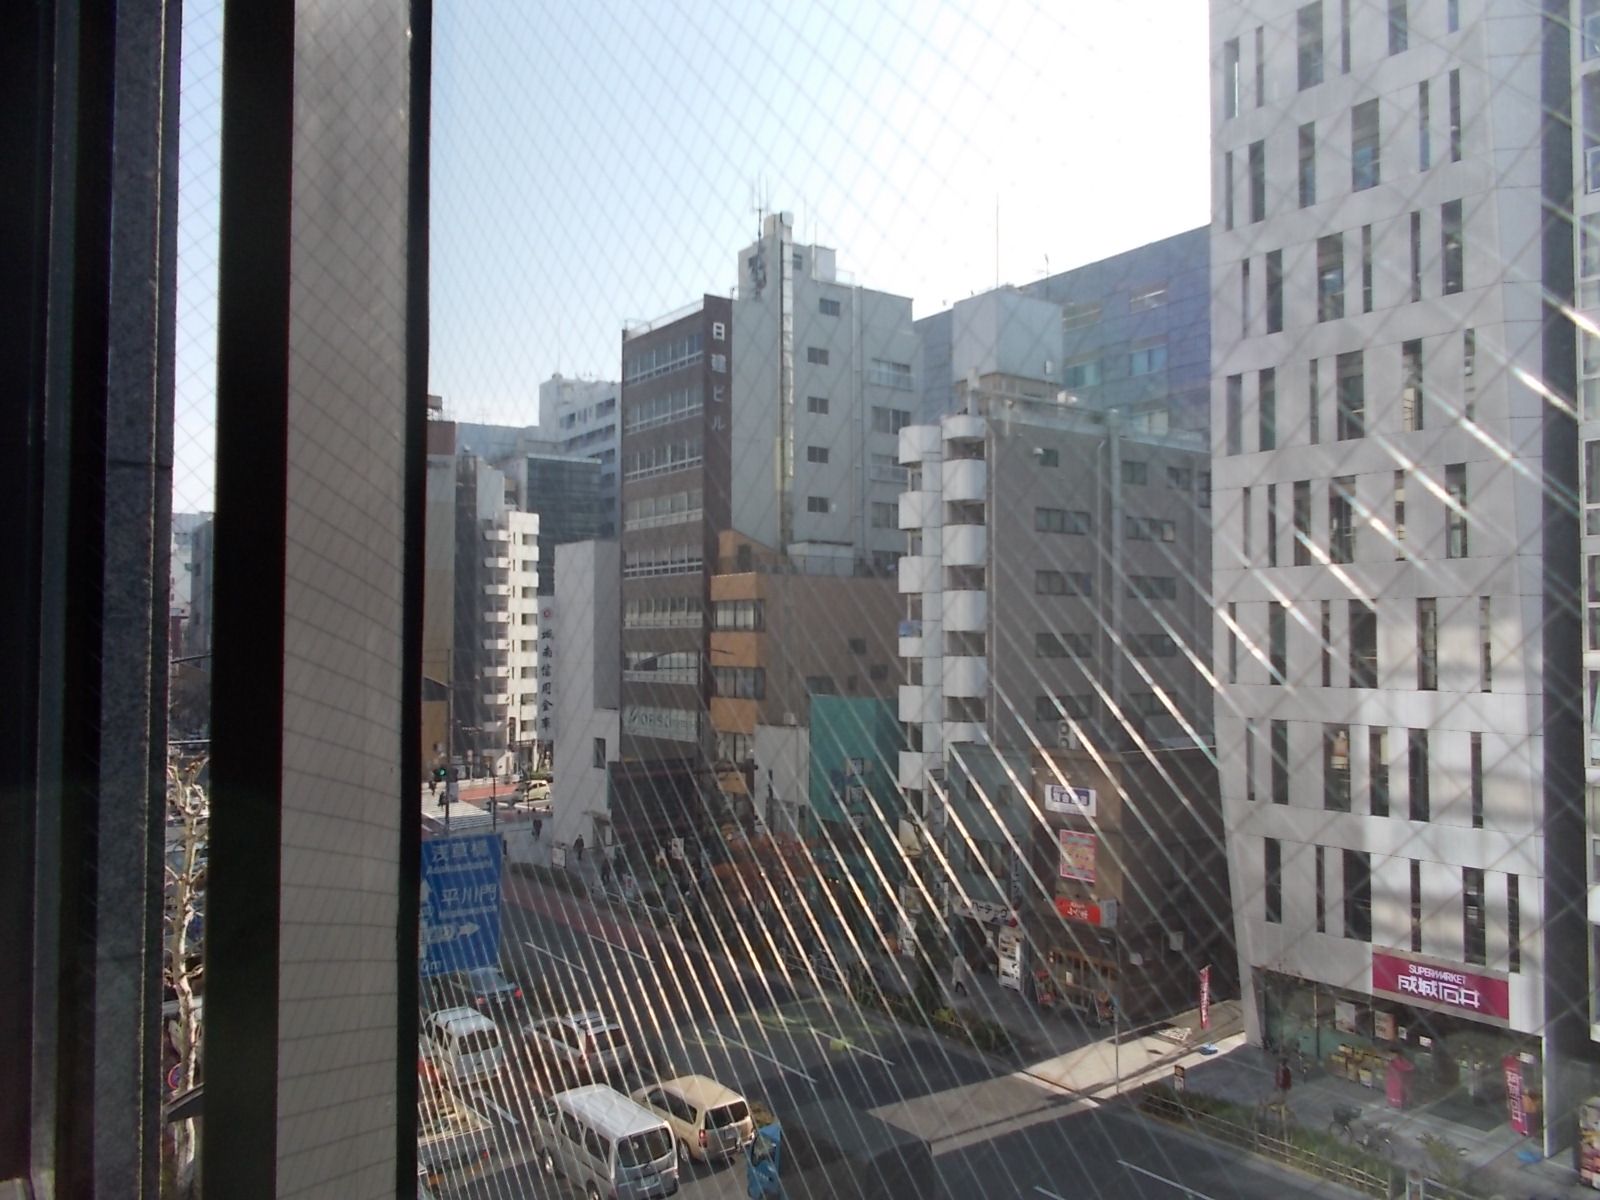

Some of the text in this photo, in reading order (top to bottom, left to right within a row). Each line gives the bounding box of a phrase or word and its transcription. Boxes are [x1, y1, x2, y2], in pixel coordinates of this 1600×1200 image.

[441, 883, 498, 907] 平川門
[1408, 963, 1467, 985] SUPERMARKET
[1397, 973, 1481, 1009] 成城石井
